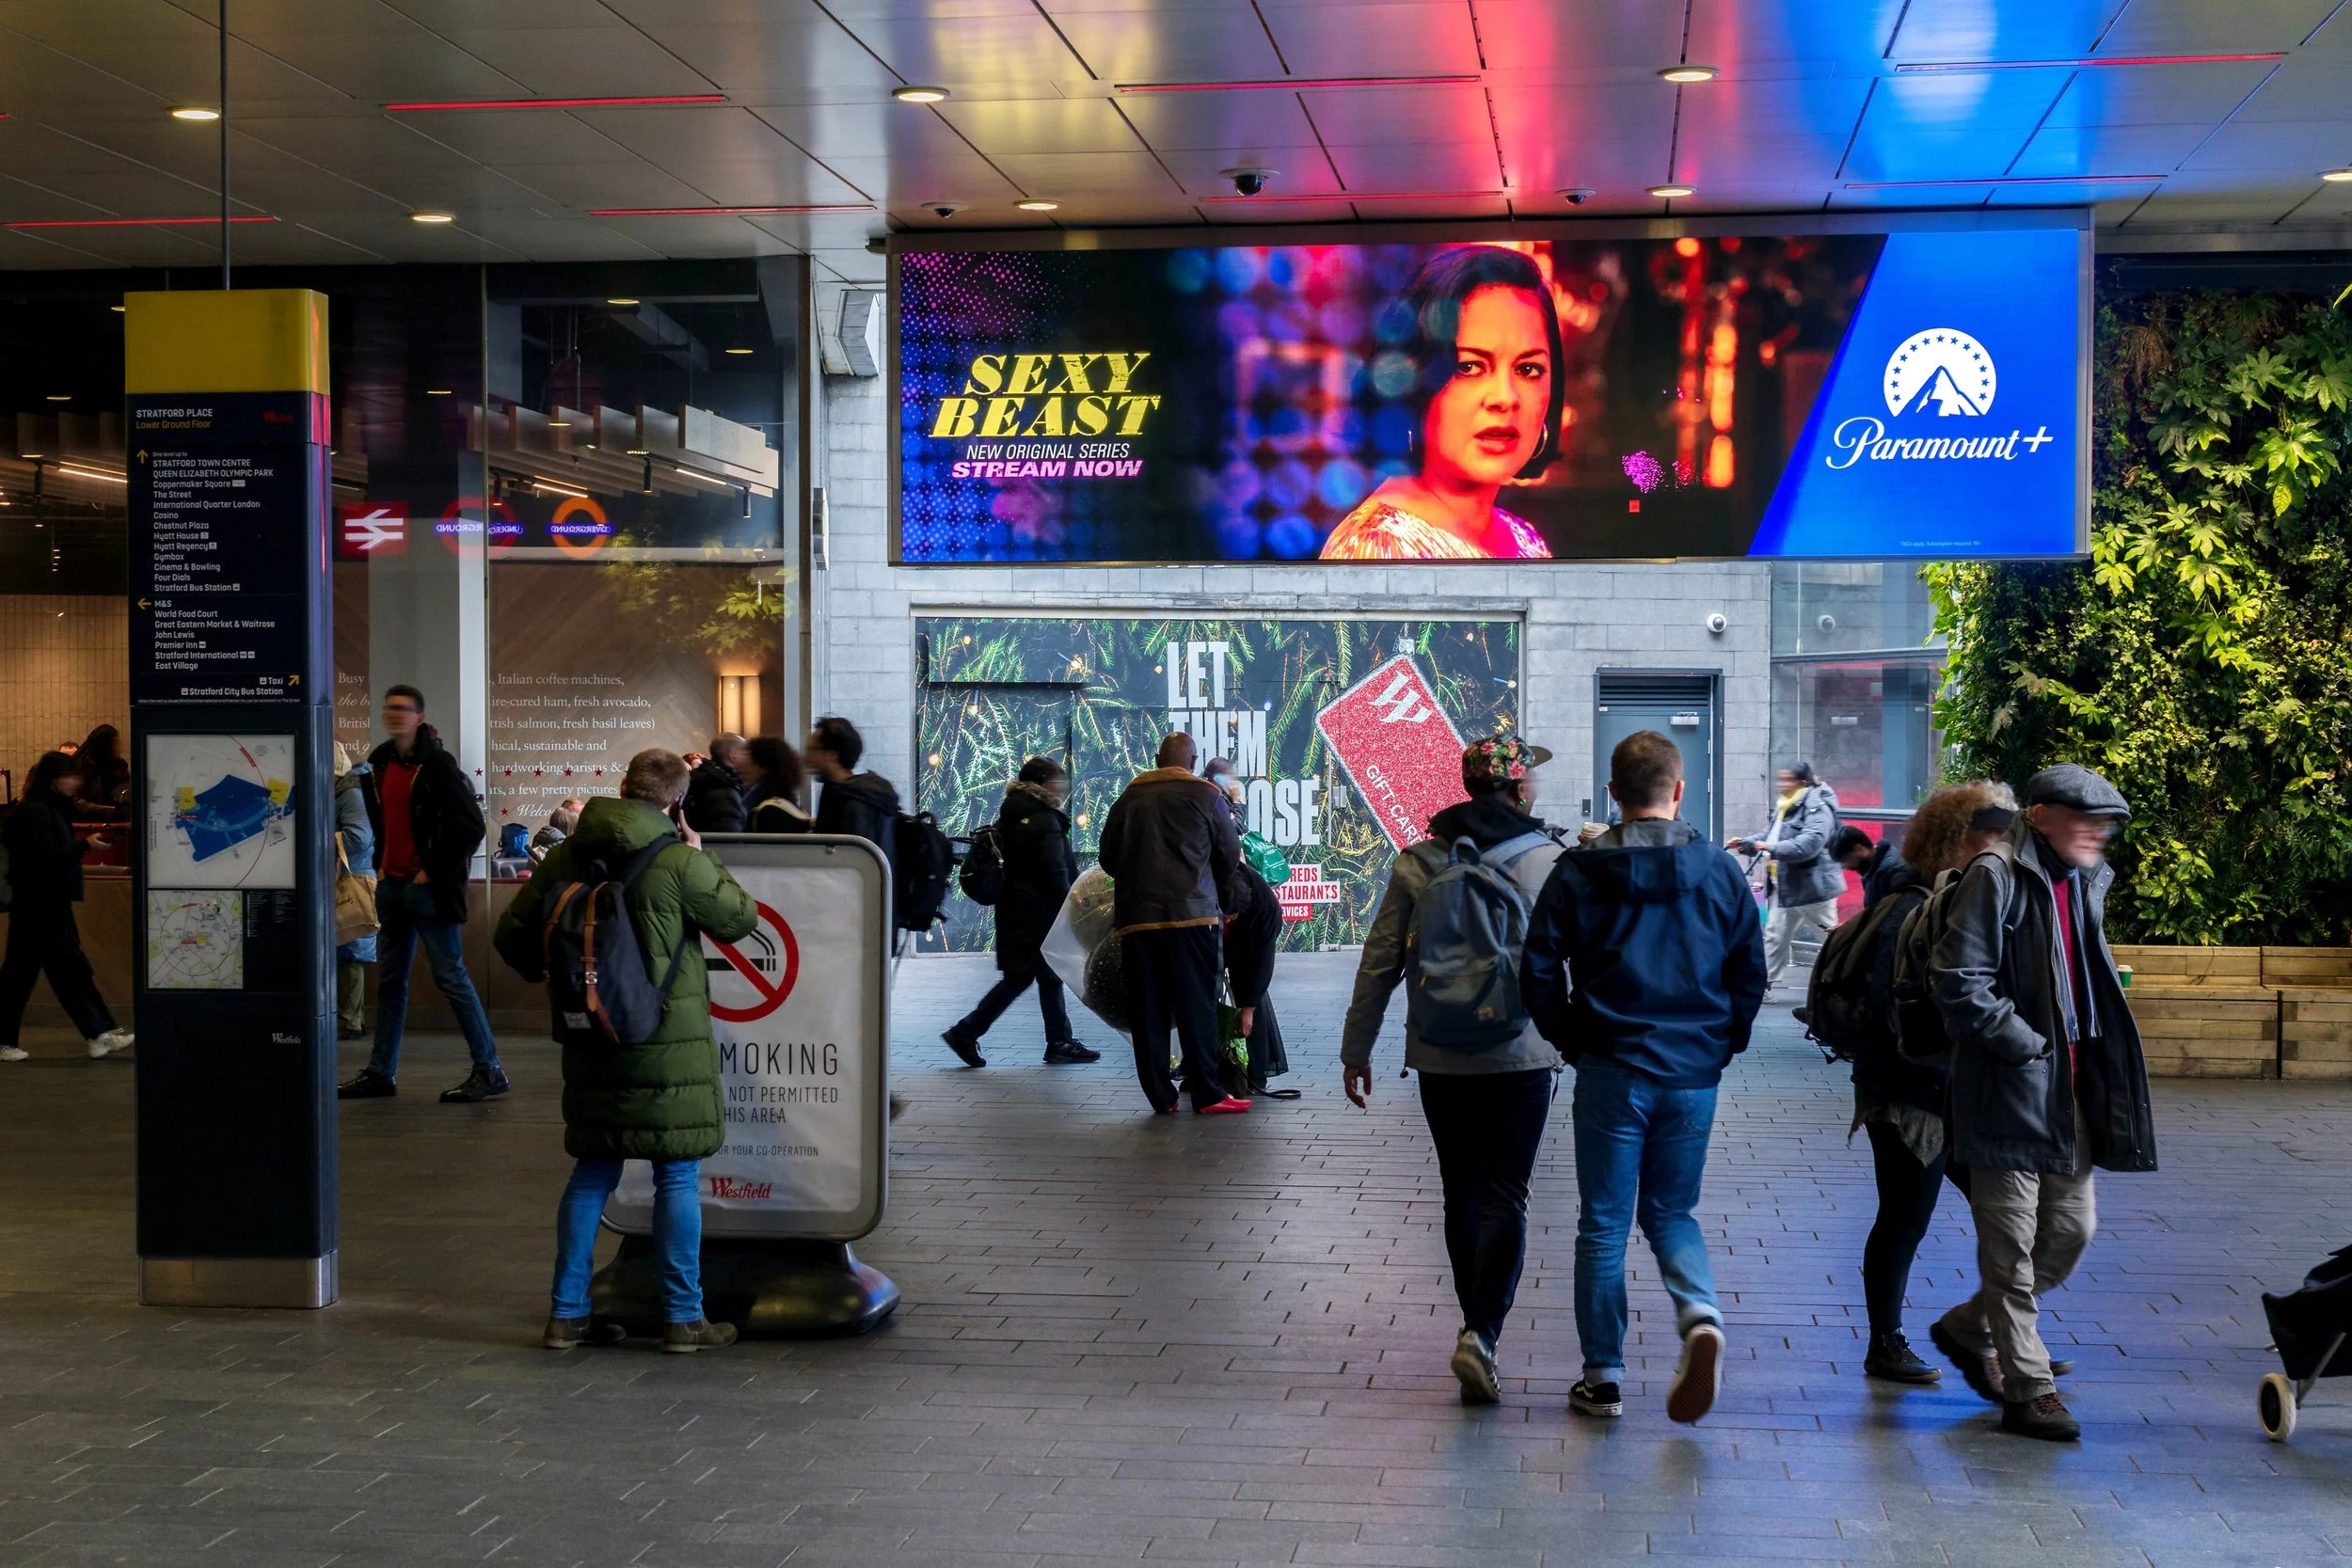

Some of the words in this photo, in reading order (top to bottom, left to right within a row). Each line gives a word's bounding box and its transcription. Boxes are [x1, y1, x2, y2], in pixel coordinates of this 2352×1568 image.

[963, 353, 1150, 395] SEXY
[136, 409, 184, 418] STRATFORD
[186, 408, 213, 417] PLACE
[928, 396, 1161, 437] BEAST
[162, 420, 190, 429] Ground
[192, 420, 211, 428] Floor
[1826, 416, 2054, 469] Paramount+
[966, 444, 1004, 459] NEW
[1006, 444, 1073, 459] ORIGINAL
[1079, 443, 1129, 458] SERIES
[153, 470, 178, 479] QUEEN
[952, 461, 1067, 478] STREAM
[1073, 460, 1143, 477] NOW
[153, 481, 203, 489] Coppermaker
[205, 481, 230, 489] Square
[154, 500, 202, 509] International
[203, 501, 232, 510] Quarter
[154, 532, 175, 542] Hyatt
[177, 532, 199, 541] House
[154, 543, 175, 552] Hyatt
[177, 543, 208, 551] Regency
[154, 553, 184, 562] Gymbox
[191, 563, 221, 572] Bowling
[155, 651, 189, 659] Stratford
[190, 651, 238, 659] International
[173, 662, 199, 671] Village
[339, 672, 365, 687] Busy
[498, 673, 532, 685] Italian
[535, 673, 567, 685] coffee
[571, 673, 624, 687] machines,
[1168, 641, 1230, 708] LET
[225, 689, 240, 697] City
[339, 692, 358, 705] the
[491, 695, 540, 706] ire-cured
[544, 696, 570, 708] ham,
[574, 696, 598, 706] fresh
[602, 696, 651, 708] avocado,
[517, 718, 560, 731] salmon,
[564, 718, 588, 728] fresh
[593, 718, 616, 728] basil
[619, 718, 655, 731] leaves)
[344, 738, 358, 751] nd
[490, 740, 520, 752] hical,
[524, 740, 582, 751] sustainable
[586, 739, 607, 751] and
[491, 761, 564, 775] hardworking
[568, 761, 608, 772] baristas
[611, 761, 622, 772] &
[1366, 765, 1395, 801] GIFT
[518, 784, 537, 795] few
[542, 785, 572, 798] pretty
[577, 784, 619, 795] pictures
[517, 803, 552, 817] Welco
[1290, 867, 1318, 882] REDS
[720, 1042, 838, 1076] MOKING
[729, 1085, 755, 1102] NOT
[760, 1086, 838, 1103] PERMITTED
[723, 1107, 745, 1123] HIS
[750, 1107, 787, 1124] AREA
[718, 1145, 729, 1155] OR
[732, 1145, 754, 1156] YOUR
[756, 1145, 819, 1157] CO-OPERATION
[709, 1176, 774, 1199] Westfield
